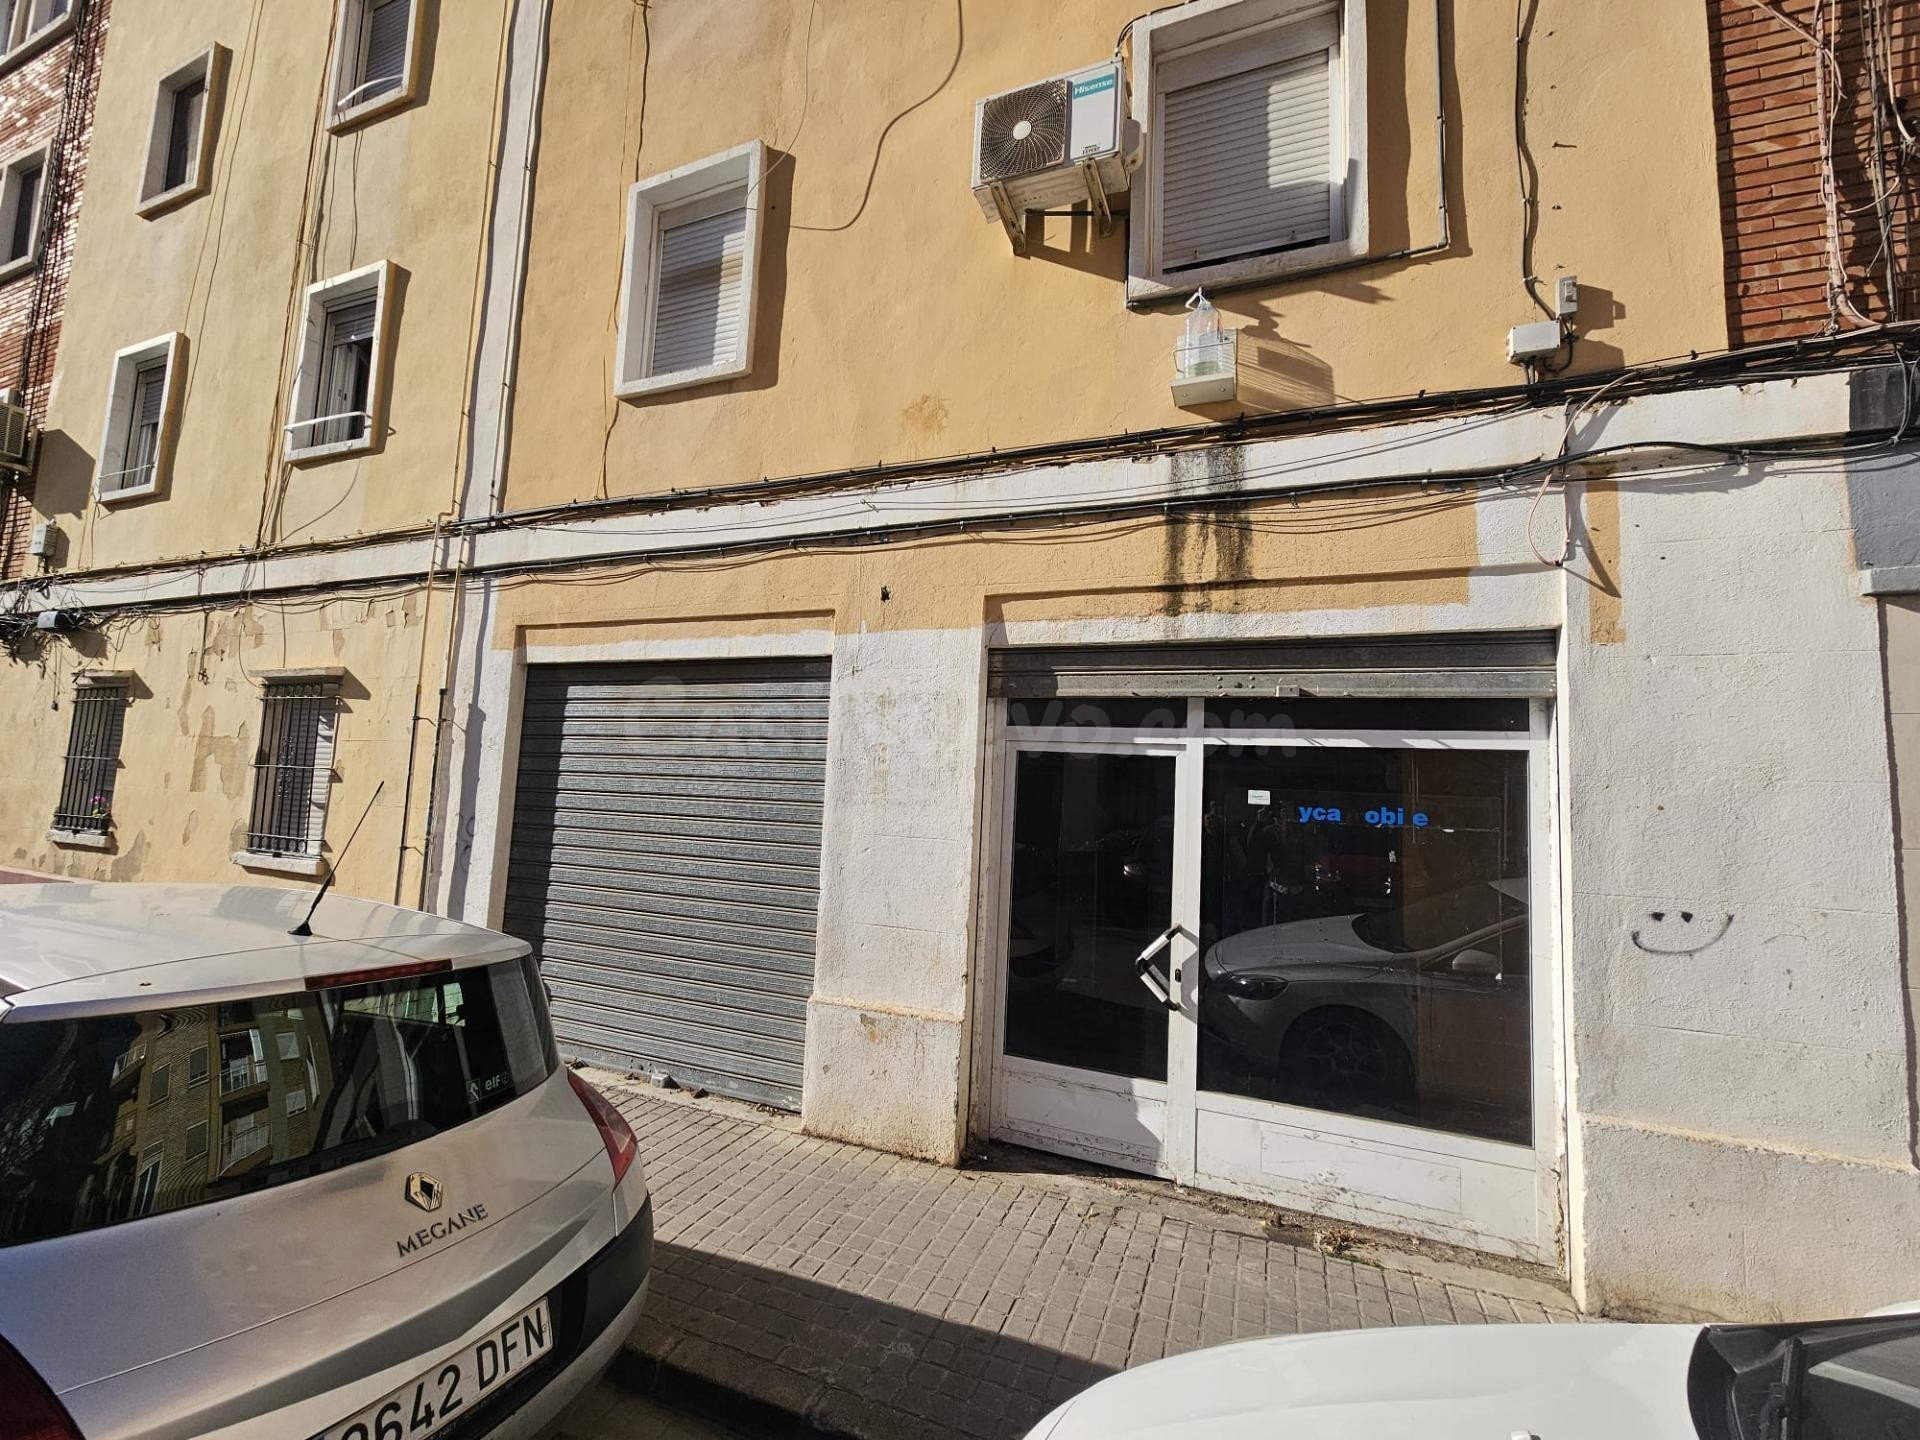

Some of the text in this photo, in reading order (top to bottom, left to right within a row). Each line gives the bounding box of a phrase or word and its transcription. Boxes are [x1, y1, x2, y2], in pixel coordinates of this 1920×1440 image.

[1074, 79, 1114, 96] Hisense
[484, 1074, 501, 1091] elf
[396, 1203, 489, 1257] MEGANE
[475, 1307, 545, 1391] DFN
